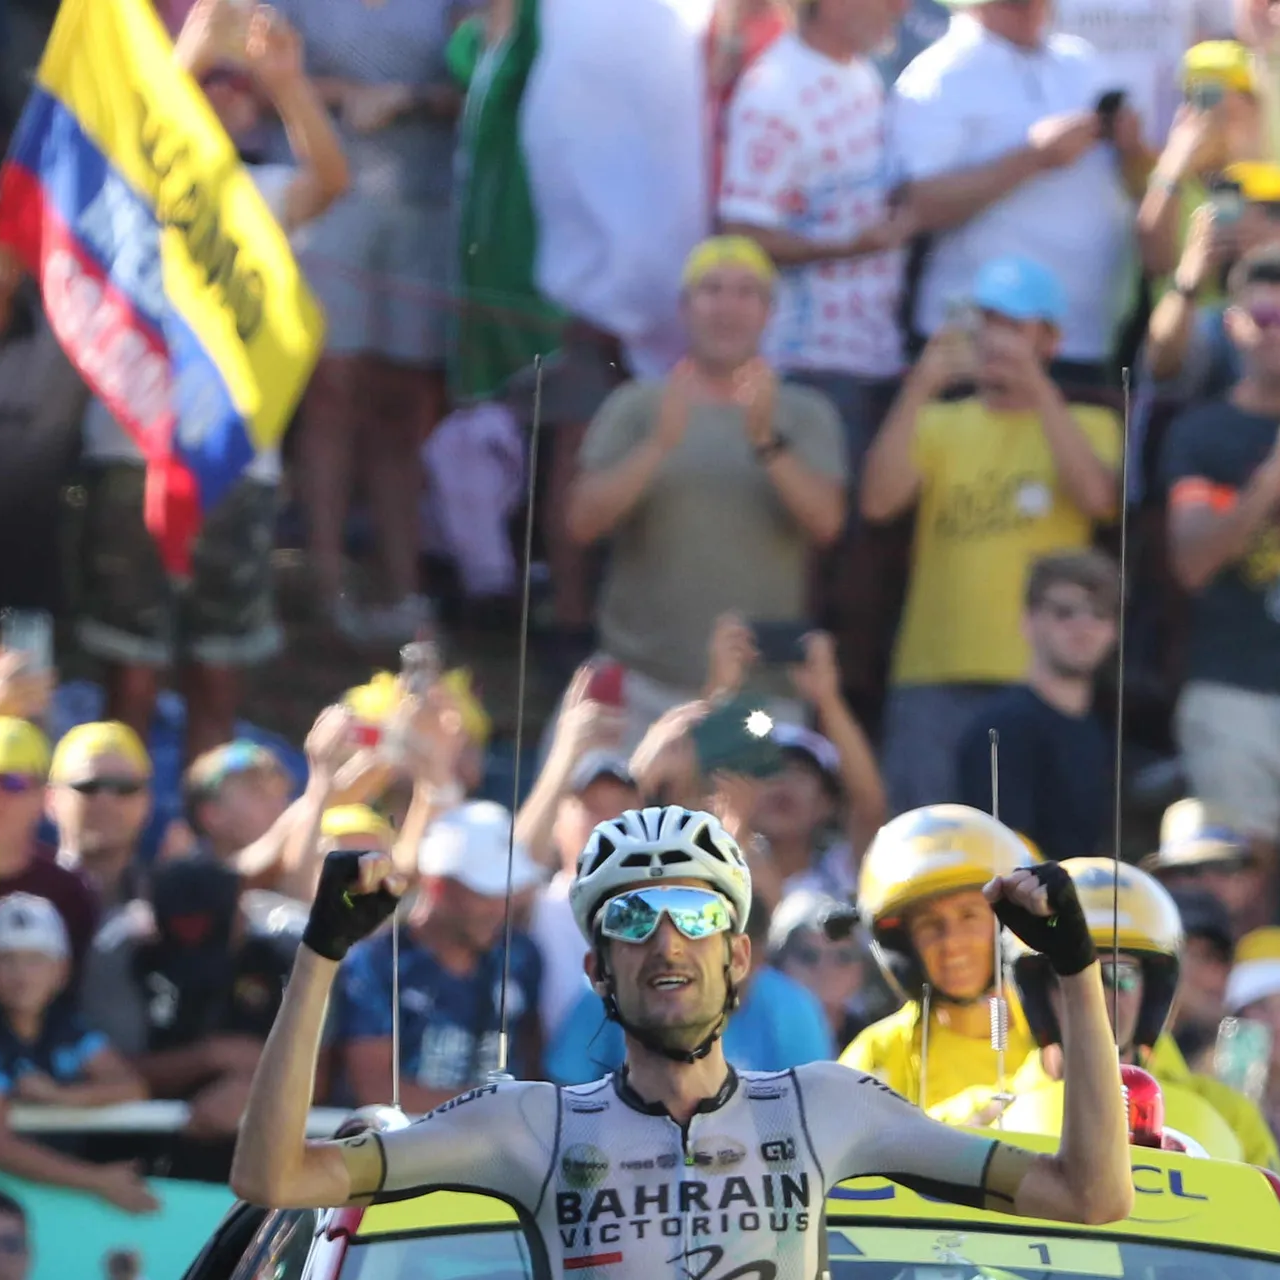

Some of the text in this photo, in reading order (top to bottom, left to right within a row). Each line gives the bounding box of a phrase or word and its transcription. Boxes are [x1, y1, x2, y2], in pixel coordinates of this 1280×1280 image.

[556, 1172, 810, 1225] BAHRAIN
[560, 1212, 809, 1248] VICTORIOUS
[1028, 1242, 1053, 1265] 1
